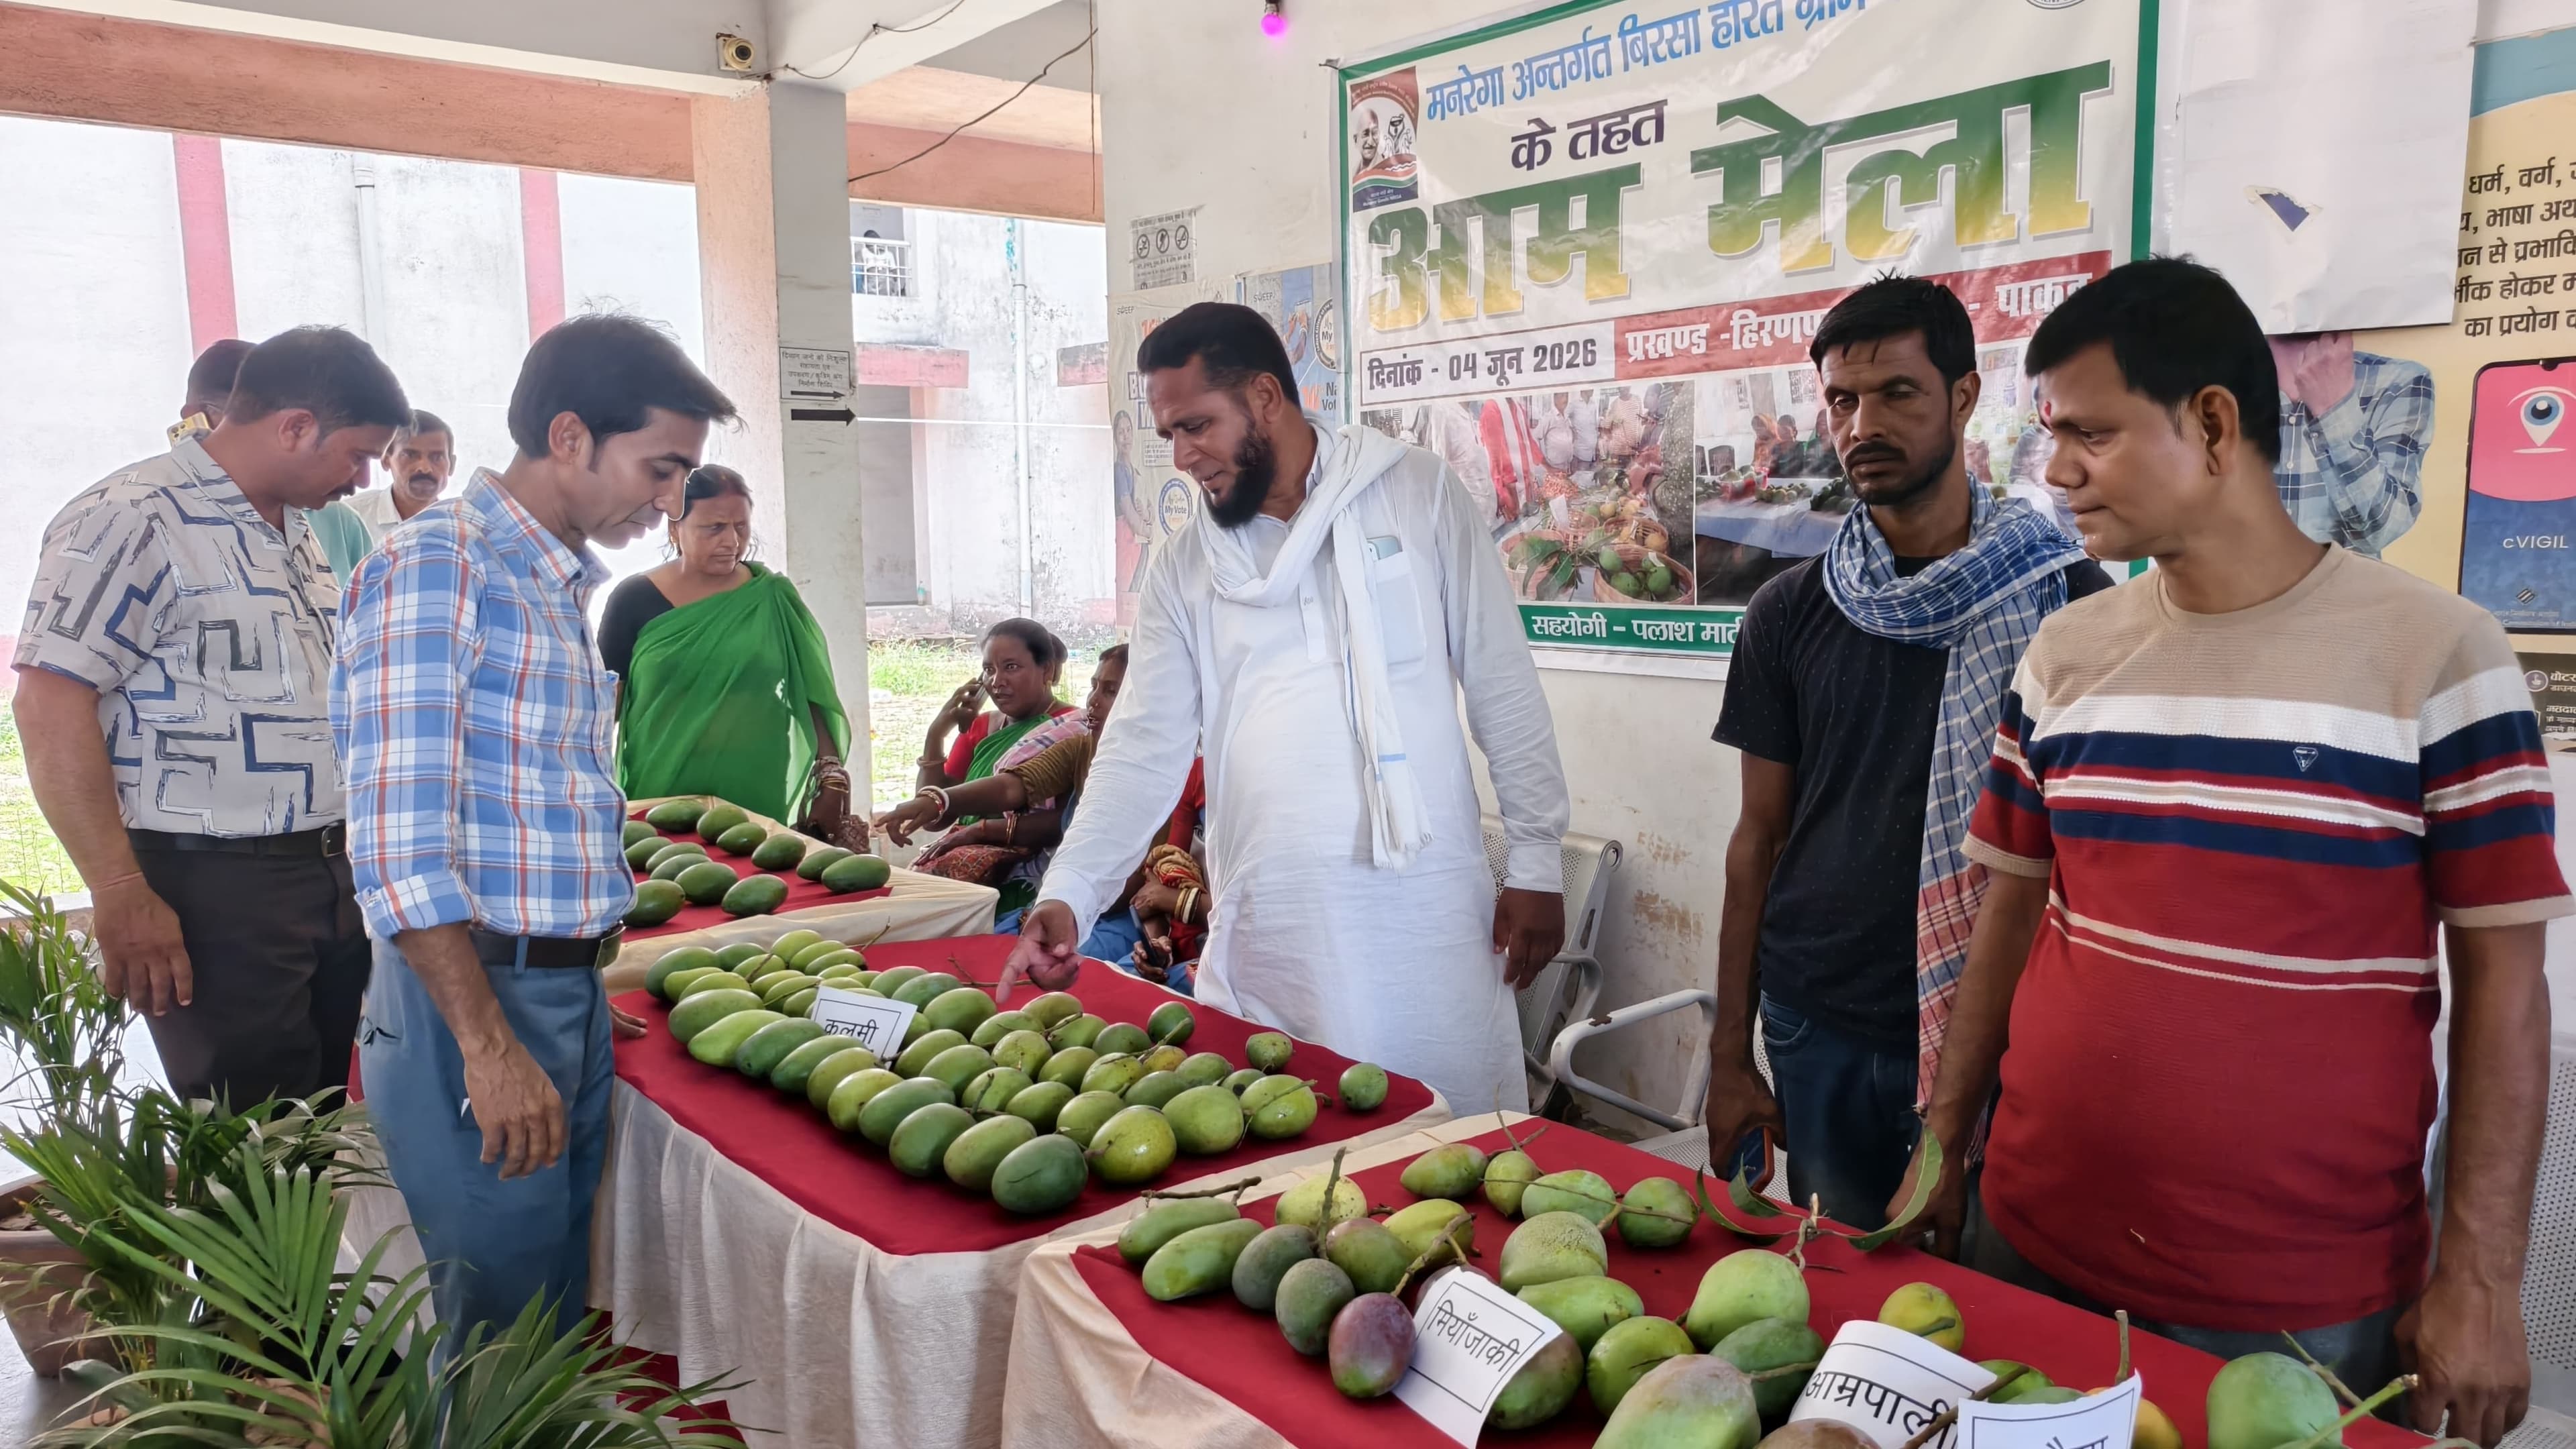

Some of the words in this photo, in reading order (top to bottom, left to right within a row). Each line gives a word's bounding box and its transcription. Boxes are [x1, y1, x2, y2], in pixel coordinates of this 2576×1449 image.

[1426, 64, 1504, 121] मनरेगा
[1512, 25, 1613, 101] अन्तर्गत
[1618, 13, 1702, 72] बिरसा
[1511, 117, 1556, 171] के
[1567, 99, 1668, 160] तहत
[2469, 164, 2510, 195] धर्म,
[2518, 157, 2561, 188] वर्ग,
[1368, 162, 1644, 332] आम
[1690, 59, 2113, 272] मेला
[2486, 204, 2534, 227] भाषा
[2489, 237, 2508, 264] से
[2500, 272, 2557, 300] होकर
[1322, 330, 1333, 342] My
[2465, 317, 2493, 337] का
[2500, 306, 2559, 337] प्रयोग
[1625, 323, 1710, 363] प्रखण्ड
[1367, 353, 1424, 390] दिनांक
[1449, 353, 1477, 381] 04
[1485, 347, 1524, 386] जून
[1534, 338, 1597, 373] 2026
[1165, 505, 1173, 515] My
[1175, 504, 1187, 514] Vote
[2503, 535, 2569, 549] cVIGIL
[1532, 612, 1607, 637] सहयोगी
[1631, 619, 1695, 642] पलाश
[825, 1019, 879, 1044] कलमी
